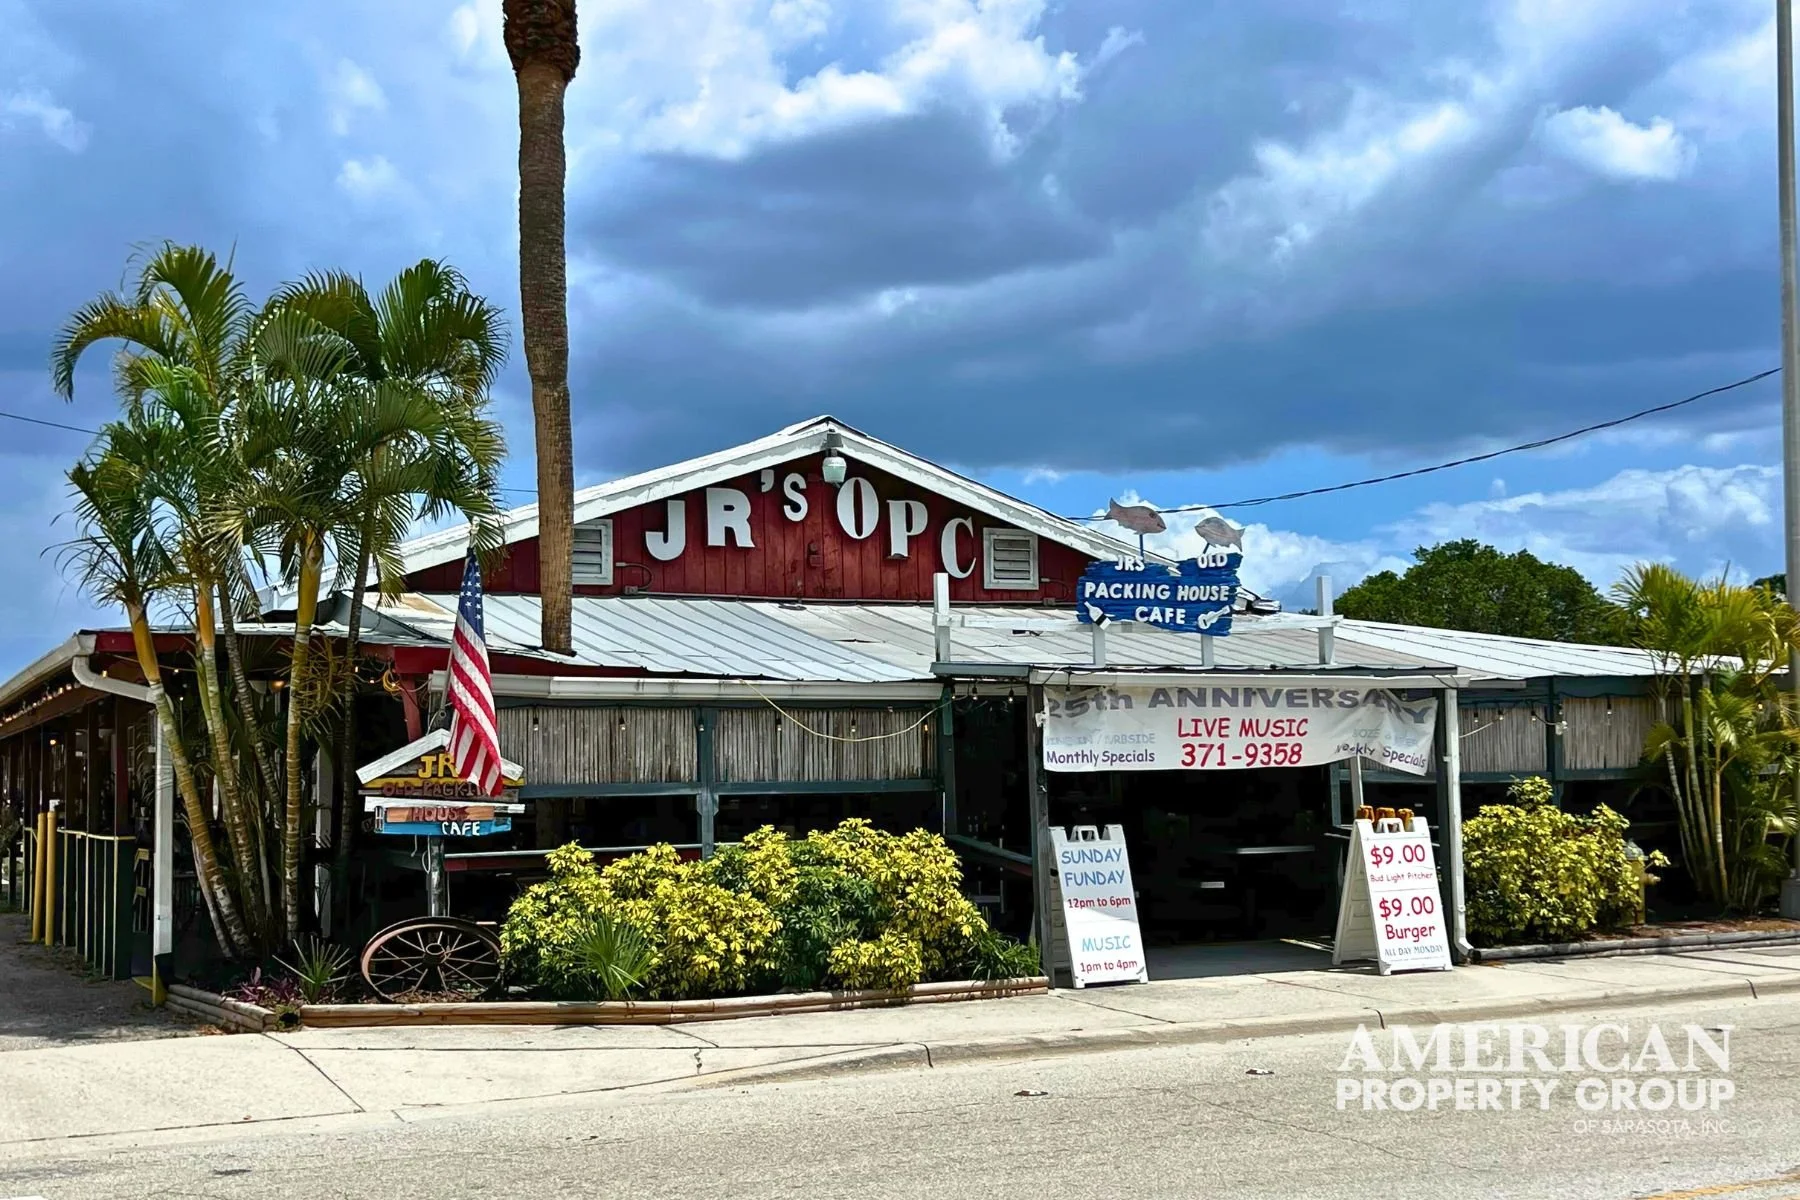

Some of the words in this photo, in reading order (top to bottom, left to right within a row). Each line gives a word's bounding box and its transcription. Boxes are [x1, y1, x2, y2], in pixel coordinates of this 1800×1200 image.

[836, 476, 977, 579] OPC
[1114, 554, 1145, 572] JRS
[1197, 553, 1228, 569] OLD
[1084, 582, 1170, 600] PACKING
[1177, 585, 1230, 601] HOUSE
[1135, 606, 1186, 625] CAFE
[1178, 717, 1231, 738] LIVE
[1239, 718, 1309, 738] MUSIC
[1047, 749, 1099, 767] Monthly
[1102, 749, 1155, 766] Specials
[1181, 743, 1303, 767] 371-9358
[1382, 746, 1427, 768] Specials
[382, 781, 415, 796] OLD
[441, 821, 481, 836] CAFE
[1061, 848, 1122, 864] SUNDAY
[1370, 844, 1425, 868] $9.00
[1064, 870, 1125, 887] FUNDAY
[1370, 873, 1384, 882] Bud
[1386, 874, 1404, 883] Light
[1407, 872, 1433, 881] Pitcher
[1068, 898, 1095, 909] 12pm
[1098, 898, 1107, 906] to
[1110, 896, 1131, 907] 6pm
[1379, 896, 1434, 921] $9.00
[1385, 924, 1436, 943] Burger
[1082, 936, 1131, 952] MUSIC
[1398, 947, 1411, 956] DAY
[1414, 945, 1443, 954] MONDAY
[1080, 962, 1101, 974] 1pm
[1104, 961, 1114, 970] to
[1116, 959, 1138, 971] 4pm
